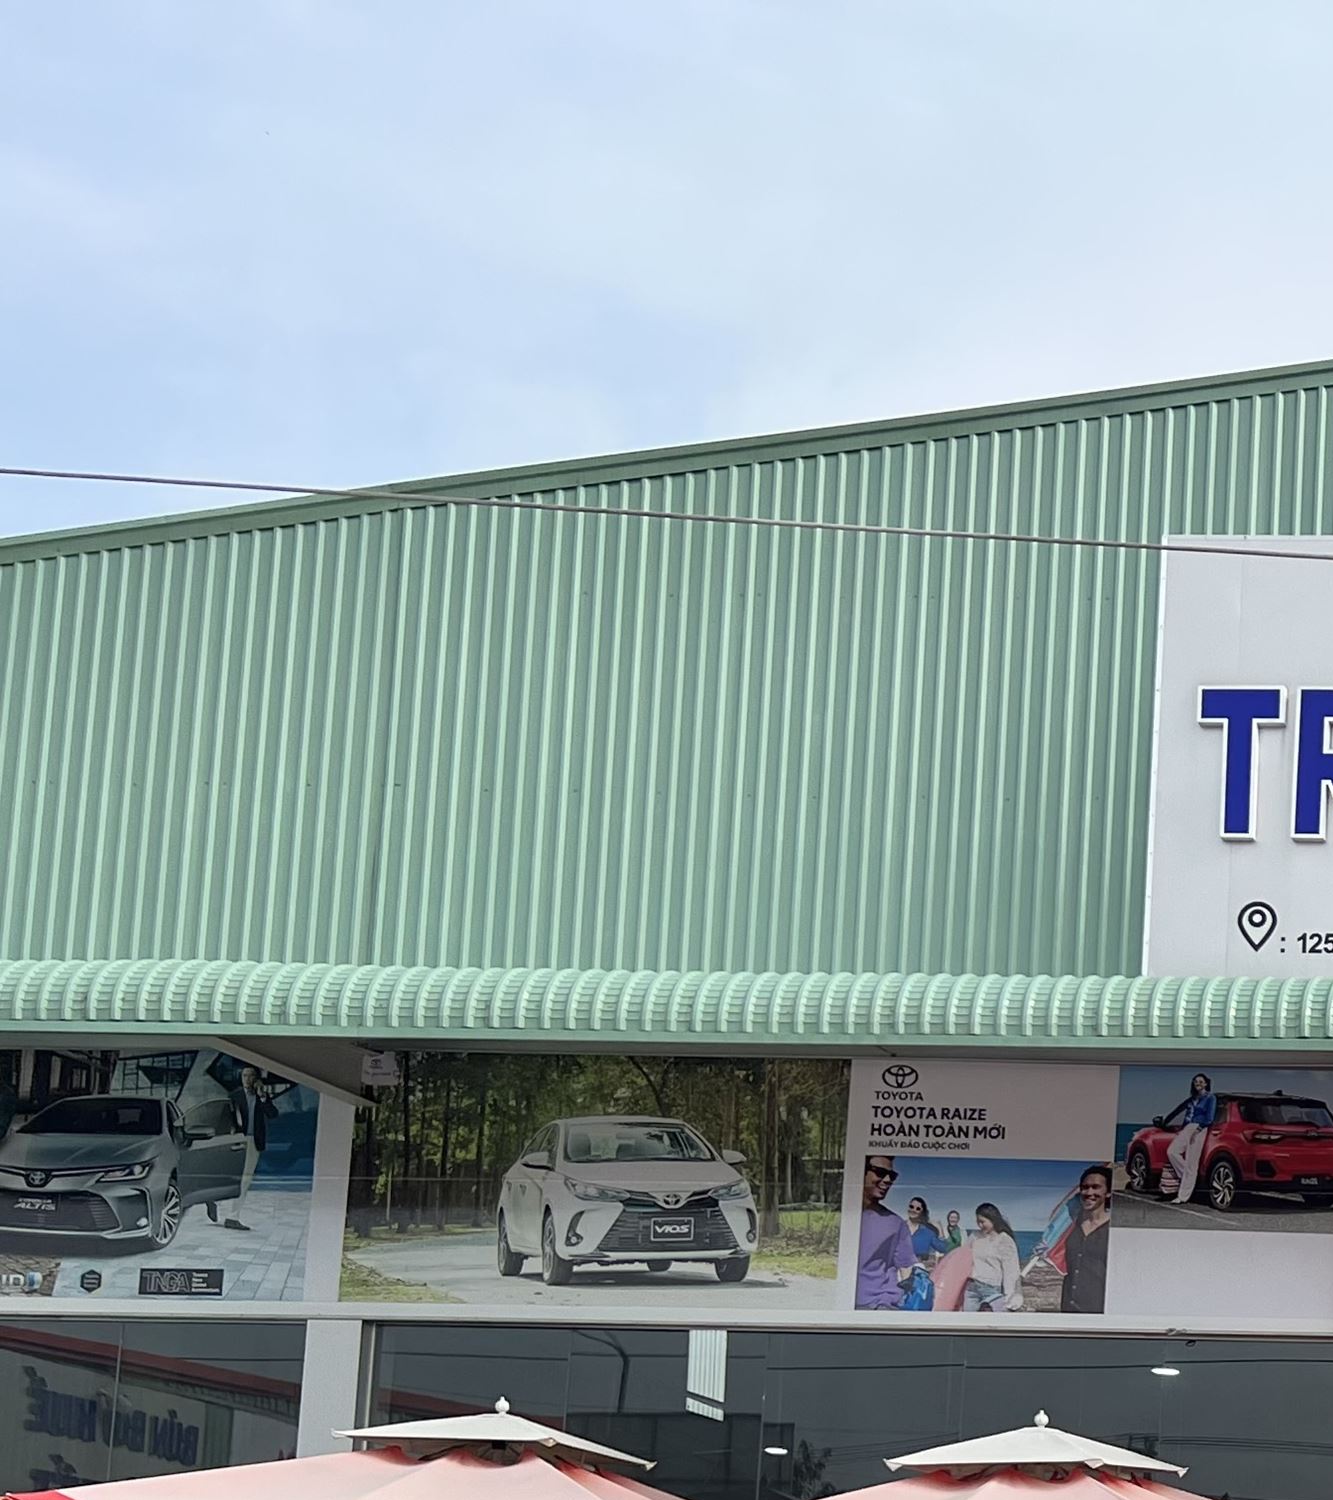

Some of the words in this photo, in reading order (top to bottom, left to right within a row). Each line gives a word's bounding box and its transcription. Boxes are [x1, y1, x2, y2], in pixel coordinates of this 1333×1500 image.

[874, 1090, 924, 1101] TOYOTA
[872, 1105, 937, 1120] TOYOTA
[941, 1107, 987, 1121] RAIZE
[870, 1121, 920, 1137] HOÀN
[923, 1122, 969, 1138] TOÀN
[973, 1123, 1006, 1139] MỚI
[922, 1141, 947, 1151] CUỘC
[654, 1224, 690, 1233] VIOS
